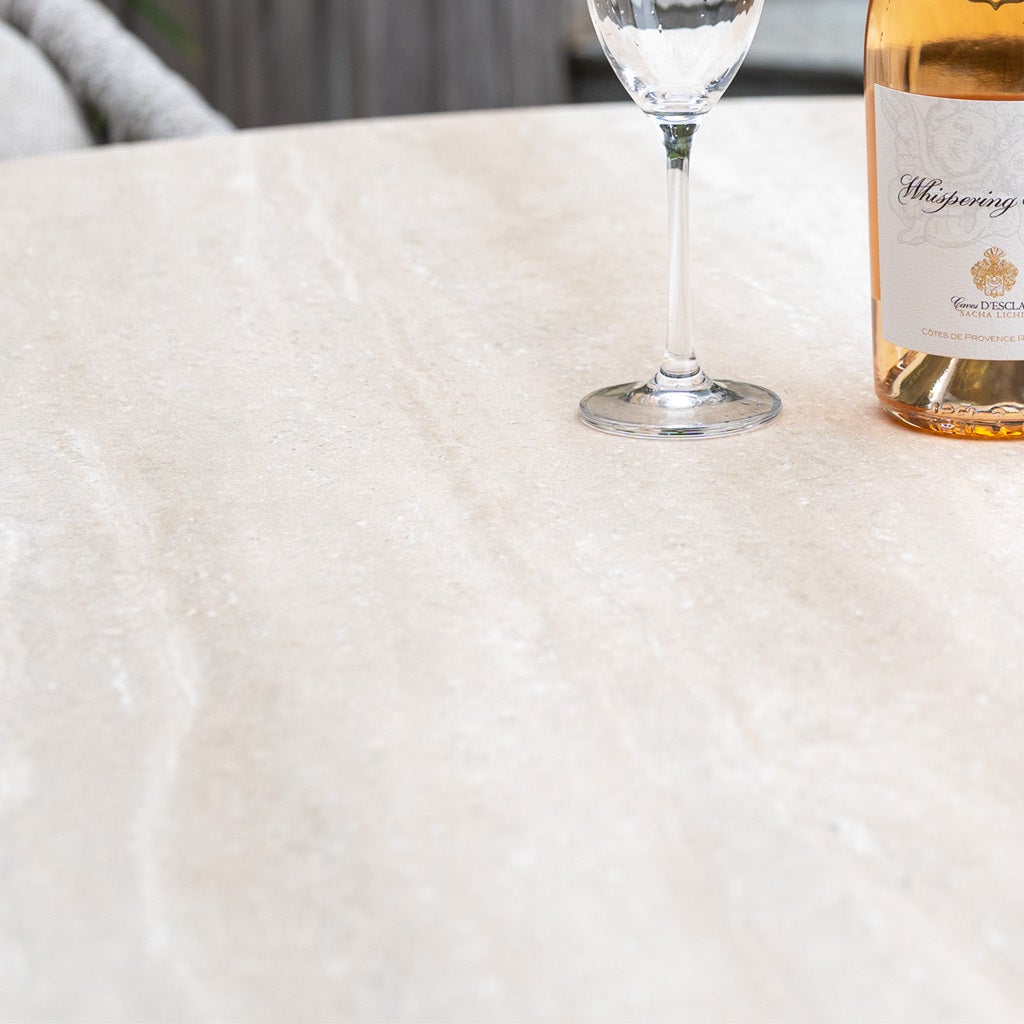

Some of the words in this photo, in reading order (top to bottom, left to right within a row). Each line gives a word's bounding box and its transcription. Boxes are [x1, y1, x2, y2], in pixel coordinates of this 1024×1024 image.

[898, 174, 1018, 218] Whispering
[951, 296, 978, 311] Caves
[960, 310, 992, 318] SACHA
[921, 328, 949, 339] CÔTES
[965, 333, 1015, 342] PROVENCE
